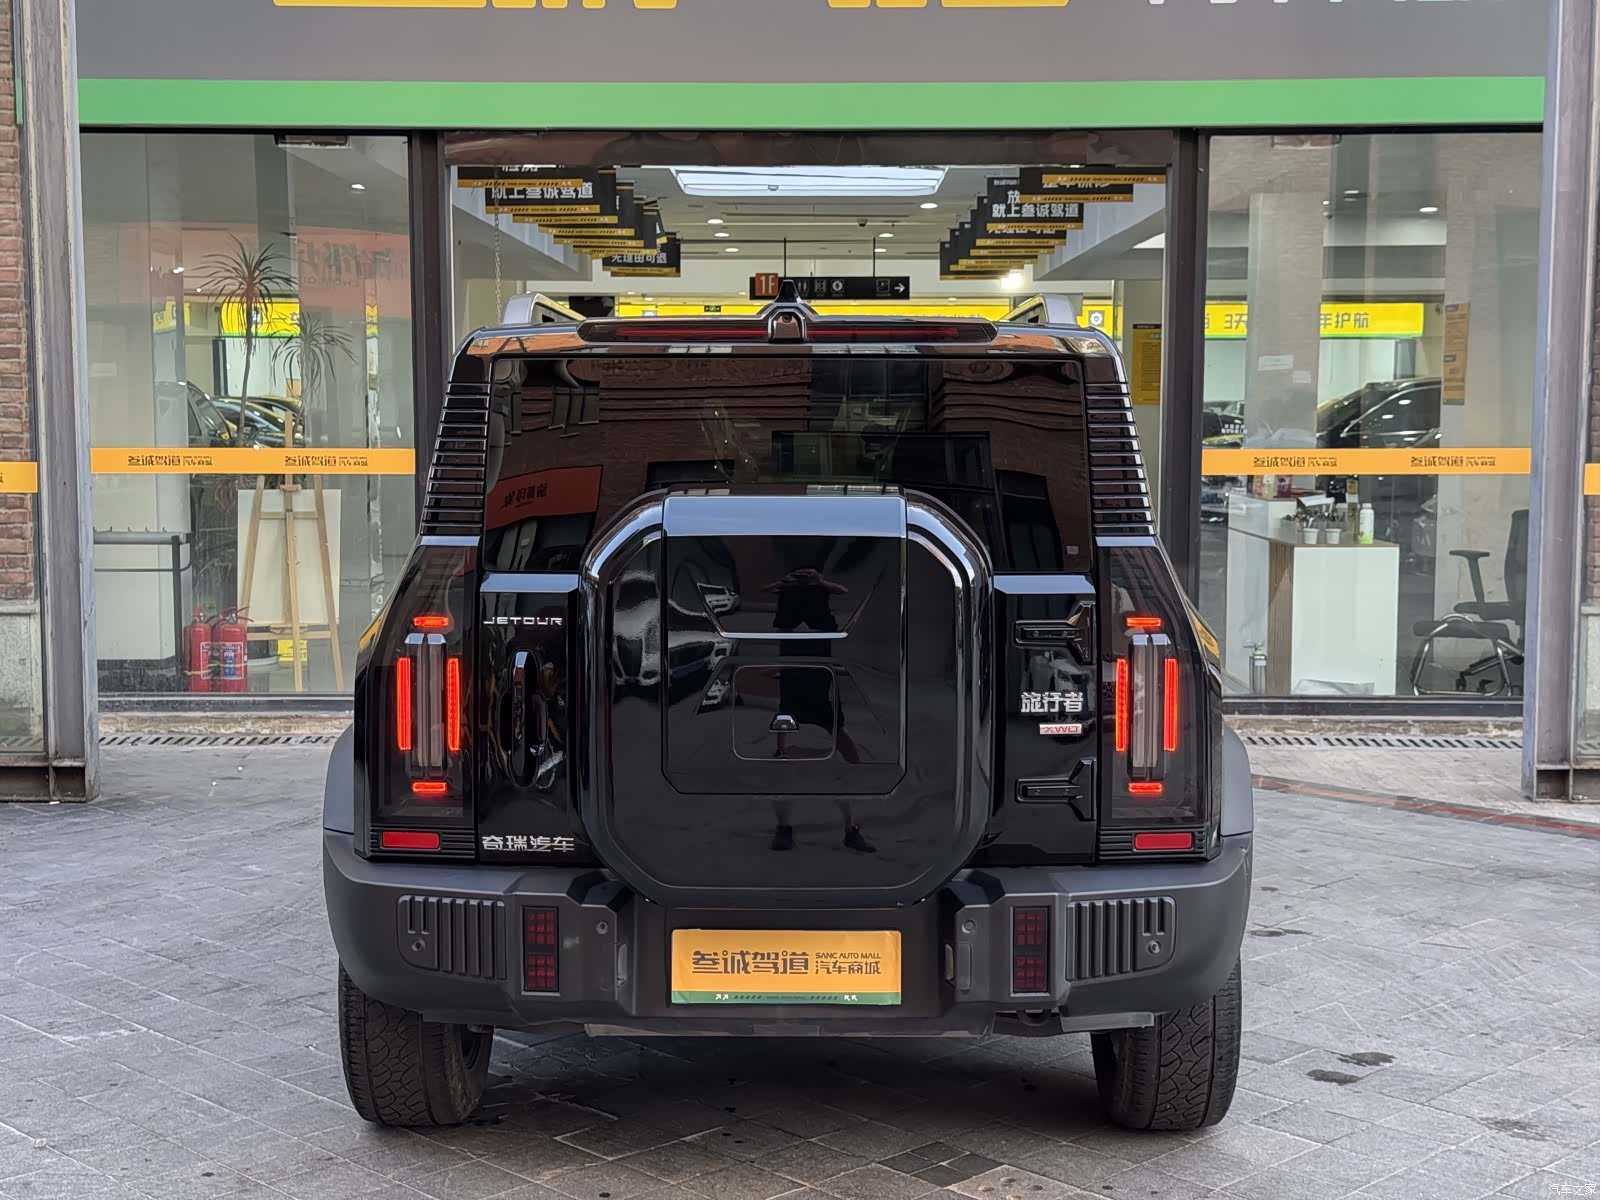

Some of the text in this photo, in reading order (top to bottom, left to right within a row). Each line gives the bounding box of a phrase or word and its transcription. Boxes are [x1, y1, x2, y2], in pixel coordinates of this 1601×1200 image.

[992, 203, 1079, 218] 就上叁诚驾道
[760, 275, 775, 294] 1F
[483, 616, 563, 626] JETOUR
[1020, 691, 1084, 713] 旅行者
[482, 835, 575, 853] 奇瑞汽车
[692, 950, 809, 975] 叁诚驾道
[815, 960, 882, 975] 汽车商城
